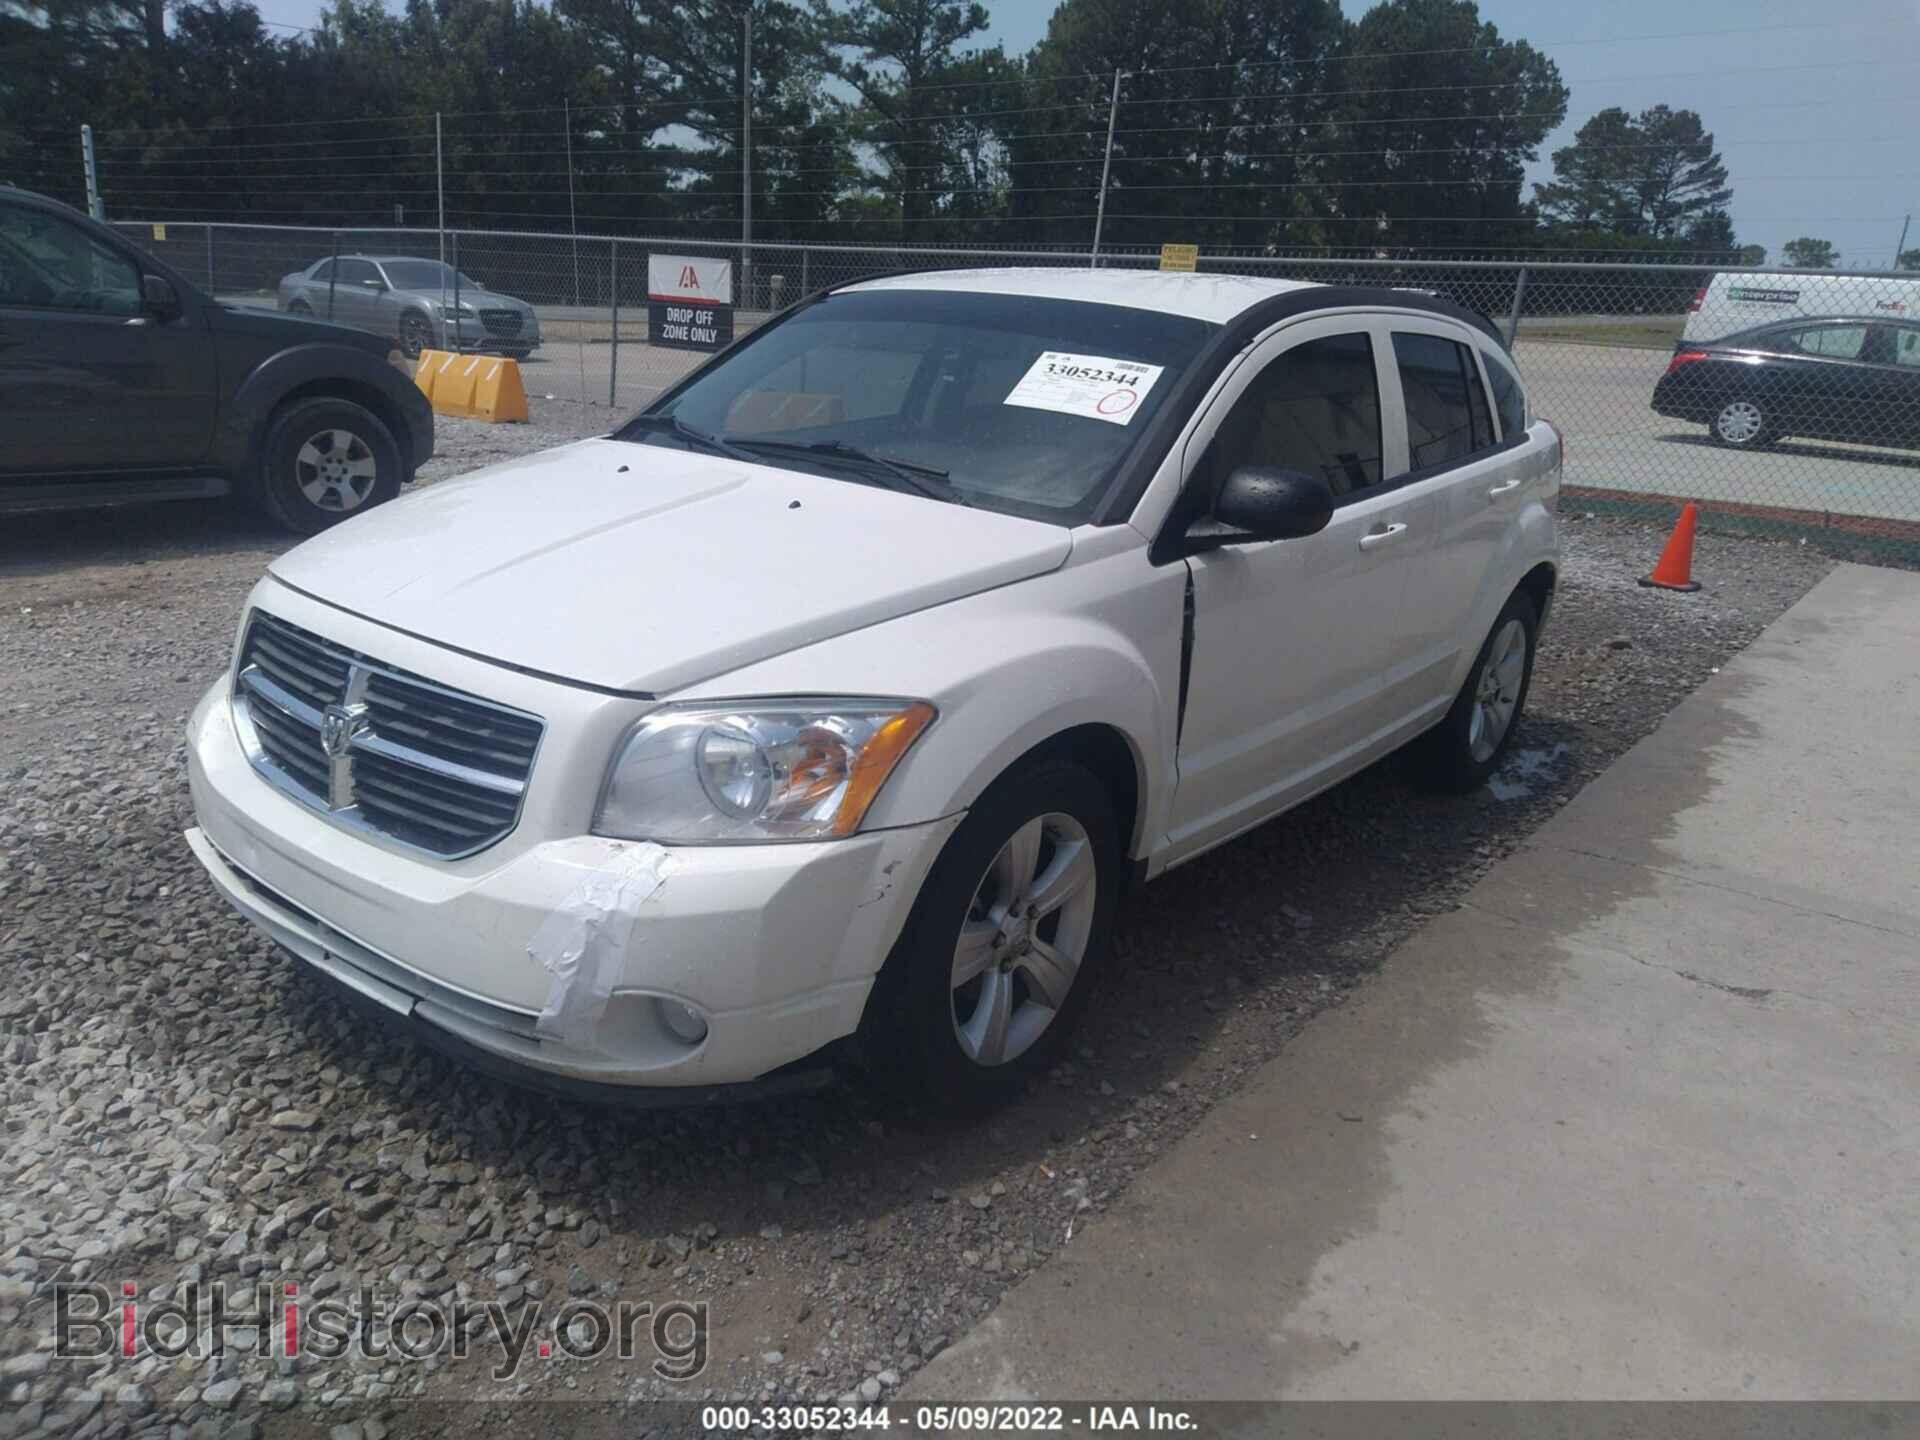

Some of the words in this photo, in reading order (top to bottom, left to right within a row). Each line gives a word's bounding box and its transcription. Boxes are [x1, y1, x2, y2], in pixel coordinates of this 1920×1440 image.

[666, 307, 693, 323] DROP
[695, 310, 714, 325] OFF
[662, 324, 688, 340] ZONE
[690, 327, 717, 343] ONLY
[1047, 363, 1140, 386] 33052344
